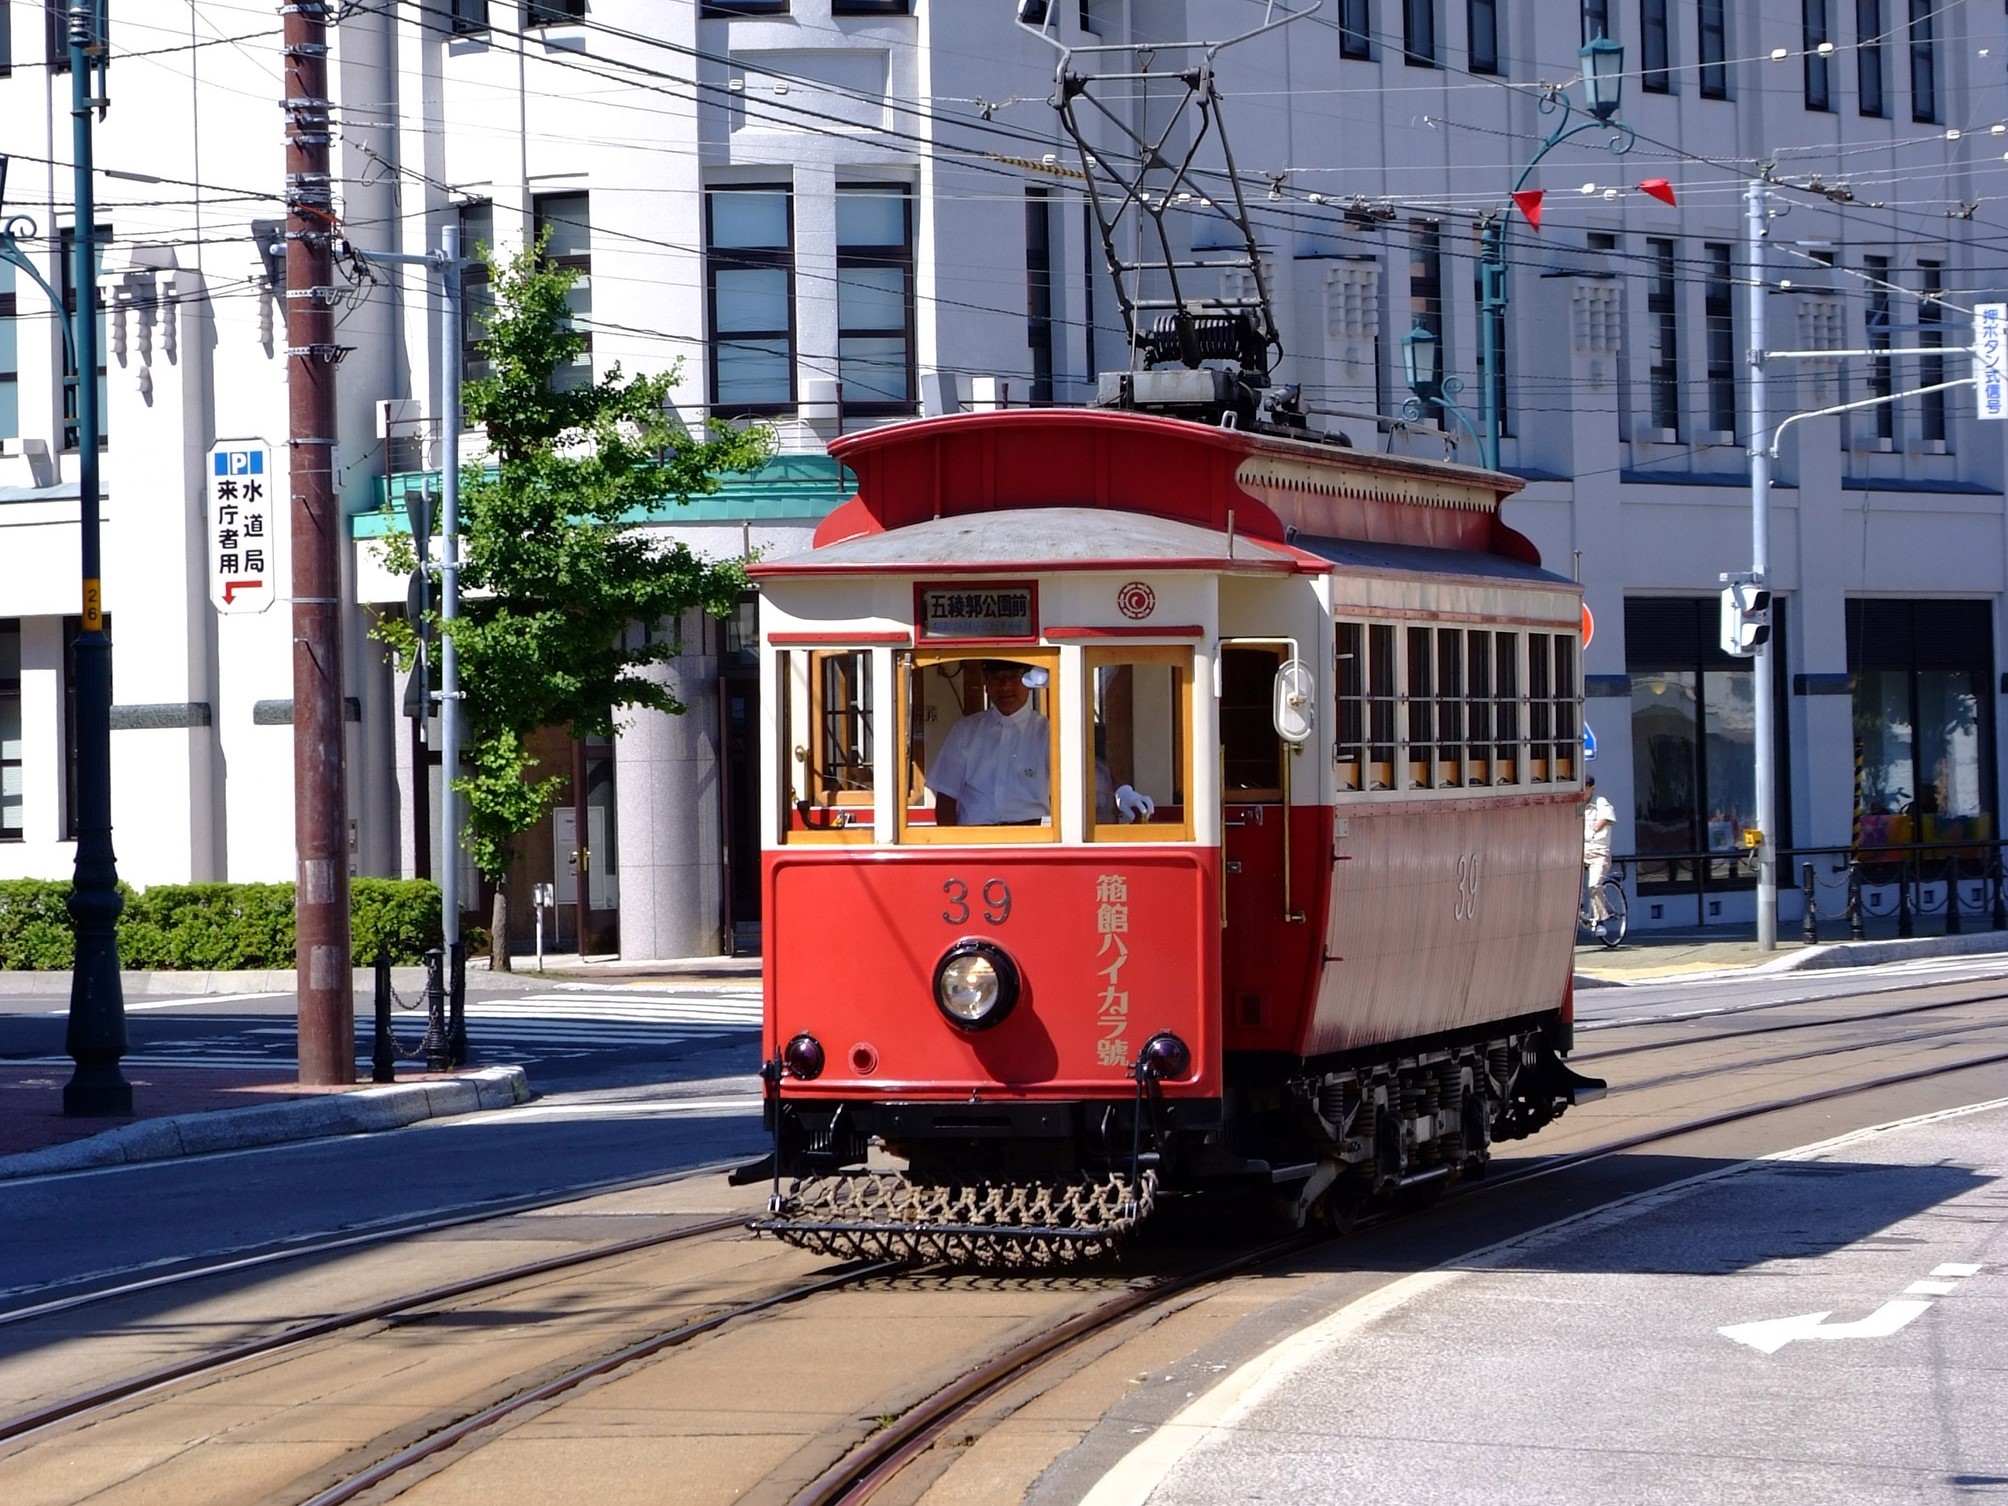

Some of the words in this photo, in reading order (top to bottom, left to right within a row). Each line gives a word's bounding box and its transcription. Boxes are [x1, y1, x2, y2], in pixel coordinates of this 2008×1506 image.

[1983, 309, 2001, 414] 押ボタン式信号
[231, 453, 247, 475] P
[217, 480, 239, 574] 来庁者用
[243, 479, 264, 573] 水道局
[88, 588, 97, 621] 26
[931, 594, 1027, 618] 五稜郭公園前
[942, 878, 1012, 926] 39
[1454, 854, 1478, 921] 39
[1096, 874, 1129, 1067] 箱館ハイカラ號
